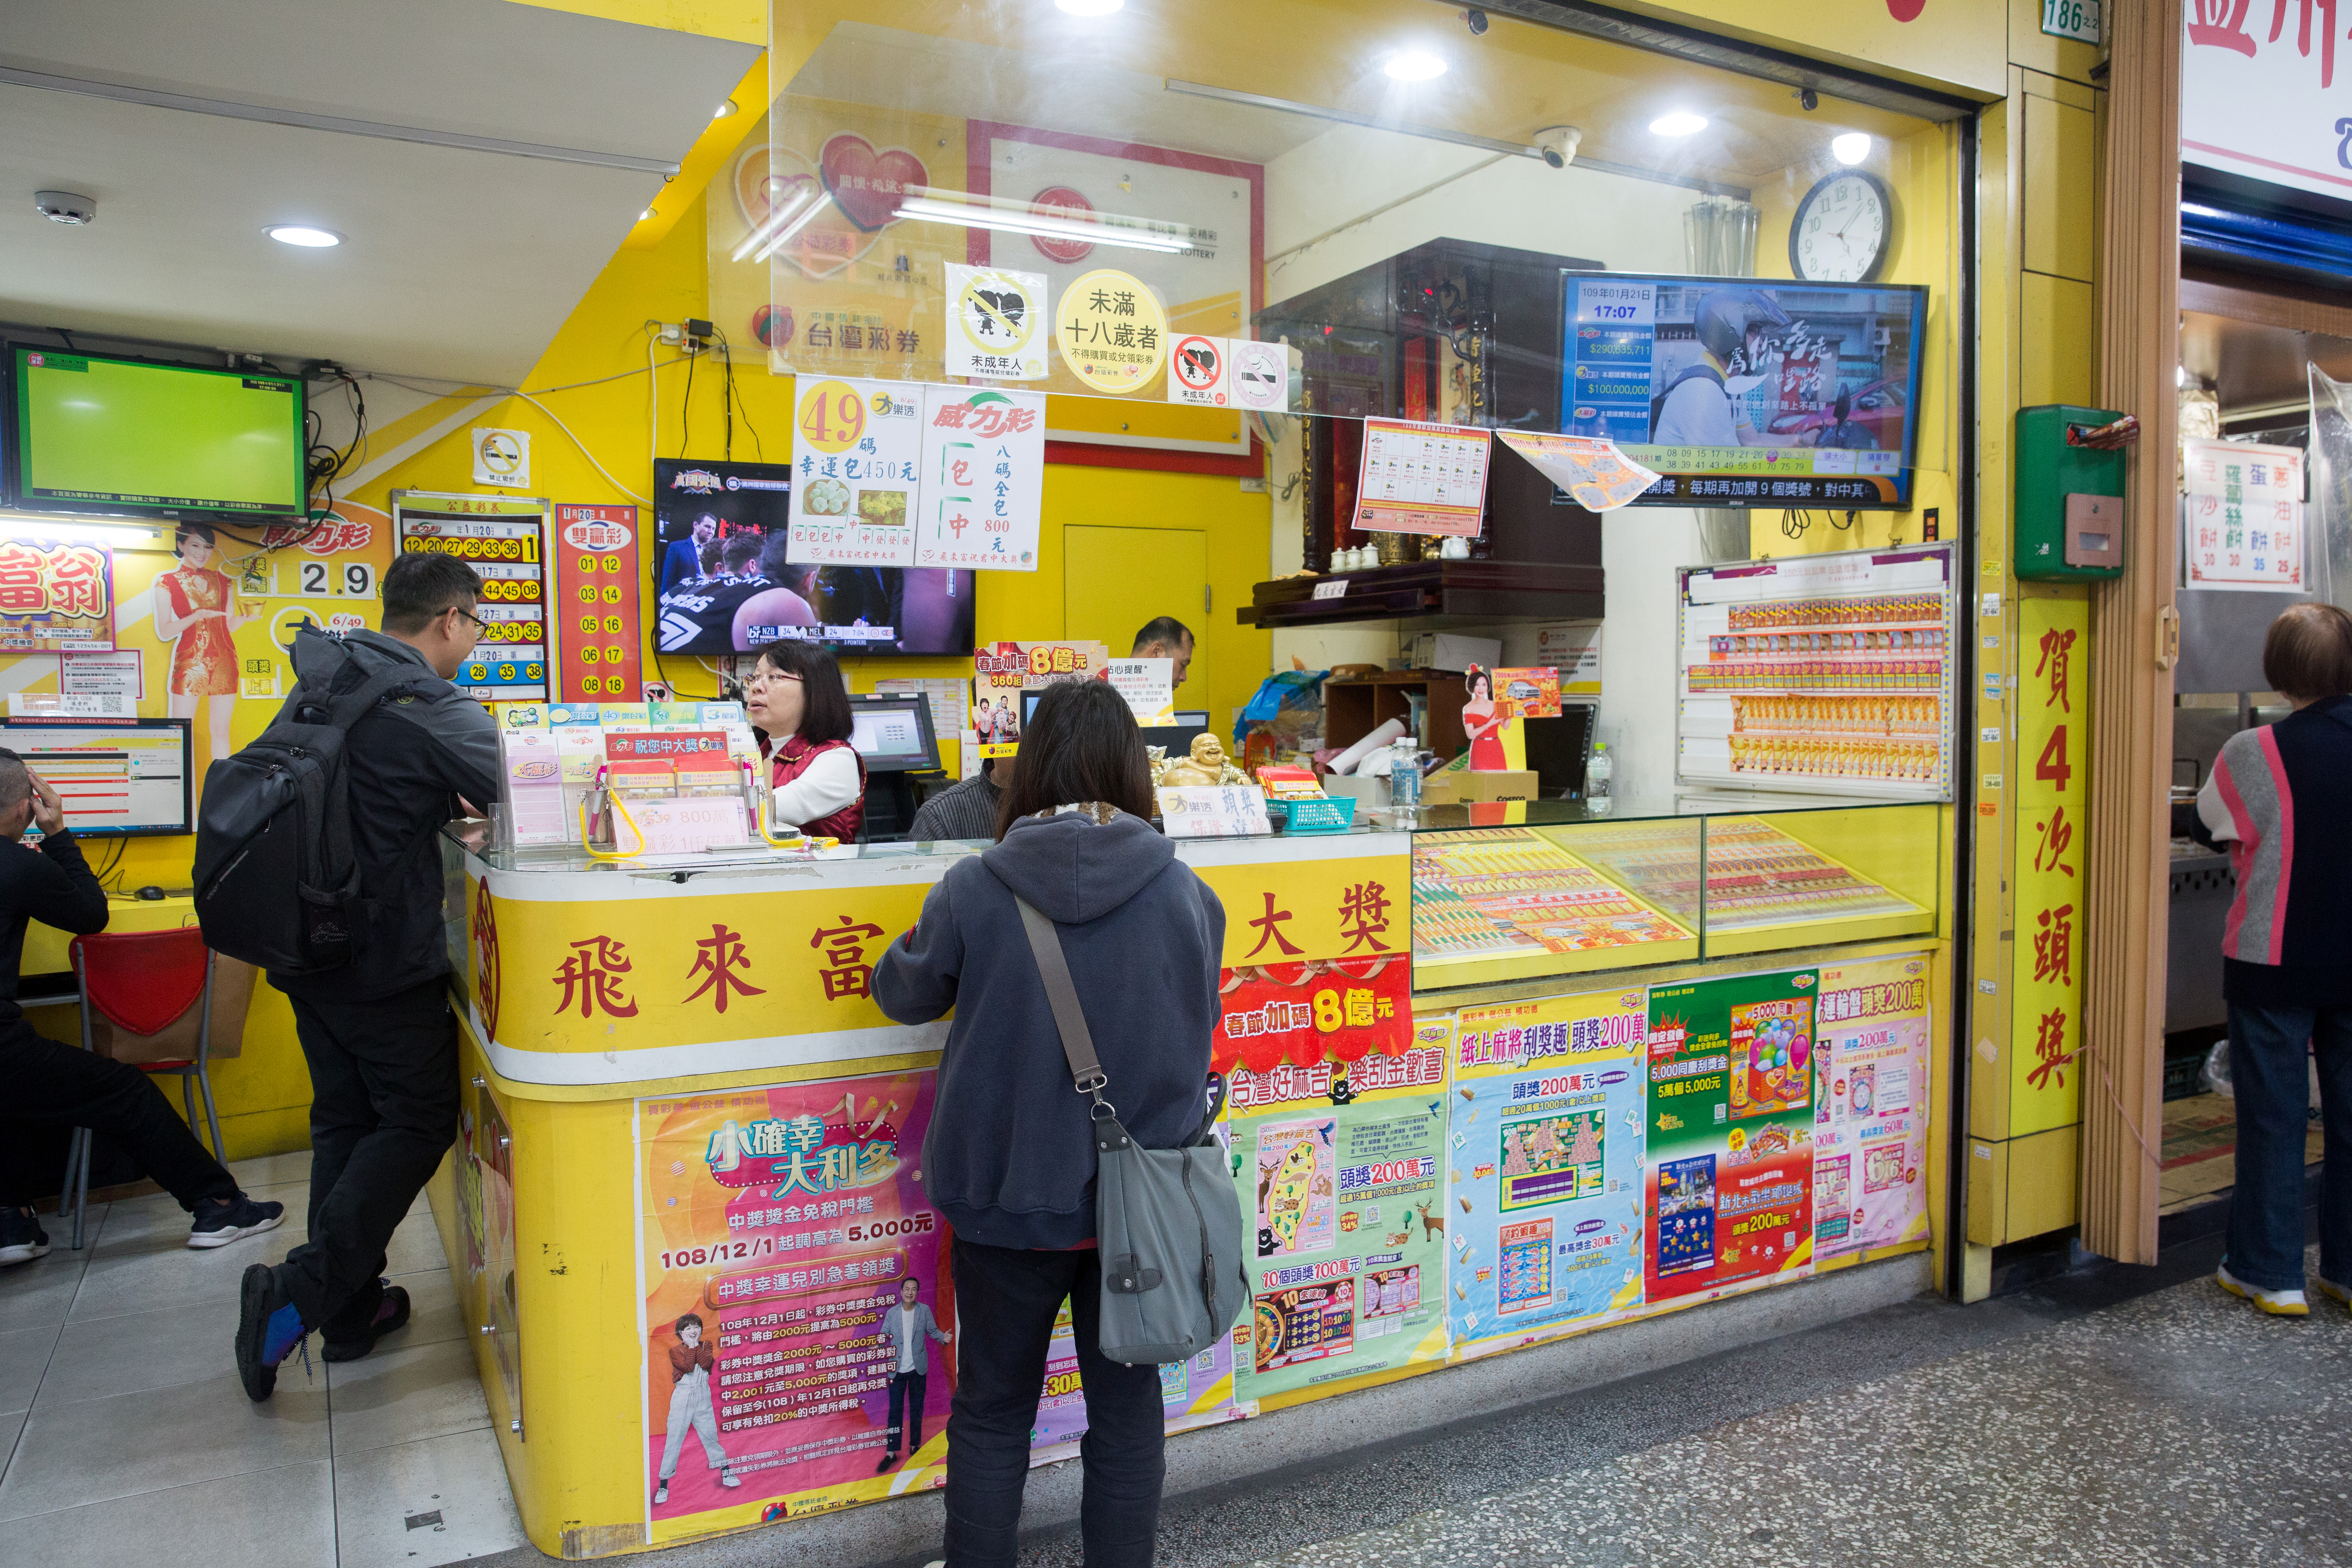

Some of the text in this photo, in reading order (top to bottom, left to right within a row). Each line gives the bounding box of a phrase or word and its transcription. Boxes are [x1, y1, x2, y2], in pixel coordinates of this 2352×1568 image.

[1180, 247, 1216, 260] LOTTERY
[1089, 289, 1135, 316] 未滿
[1583, 288, 1650, 301] 109年01月21日
[1594, 305, 1637, 318] 17:07
[808, 323, 920, 353] 台灣彩券
[1066, 318, 1158, 350] 十八歲者
[1071, 348, 1154, 365] 不得購買或兌領彩券
[1590, 344, 1650, 355] $290,635,711
[971, 355, 1022, 370] 未成年人
[974, 368, 1020, 376] 不得購買或兌領彩券
[1182, 390, 1214, 400] 未成年人
[1588, 384, 1649, 395] $100,000,000
[900, 396, 915, 405] 6/49
[803, 391, 877, 454] 49 碼
[933, 392, 1037, 439] 威力彩
[799, 455, 917, 482] 幸運包450元
[446, 500, 502, 514] 公益彩券
[2199, 459, 2218, 549] 豆沙餅
[2250, 464, 2268, 551] 蛋餅
[410, 522, 442, 536] 威力彩
[849, 520, 858, 530] 中
[572, 527, 622, 545] 雙贏彩
[406, 537, 535, 560] 12 20 27 29 33 36 1
[828, 549, 896, 560] 飛來富祝君中大獎
[581, 559, 617, 570] 01 12
[939, 551, 1018, 564] 飛來富祝君中大獎
[2204, 554, 2289, 573] 30 30 35 25
[303, 564, 368, 594] 2.9
[485, 584, 538, 597] 44 45 08
[581, 588, 618, 601] 03 14
[333, 616, 361, 627] 6/49
[581, 619, 619, 631] 05 16
[489, 624, 540, 638] 24 31 35
[762, 627, 775, 635] NZB
[809, 628, 822, 636] MEL
[583, 650, 619, 662] 06 17
[247, 659, 270, 673] 頭獎
[473, 665, 540, 677] 28 35 38
[248, 679, 271, 695] 上看
[584, 680, 622, 691] 08 18
[635, 738, 699, 754] 祝您中大獎
[519, 762, 558, 776] 大福彩
[1168, 795, 1214, 813] 大樂透
[680, 809, 729, 824] 800萬
[2027, 627, 2077, 1091] 賀4次頭獎
[552, 880, 1392, 1019] 飛來富 大獎
[1861, 980, 1924, 1016] 頭獎200萬
[1571, 1013, 1645, 1053] 頭獎200萬
[1844, 1031, 1896, 1049] 頭獎200萬元
[1232, 1047, 1443, 1105] 台灣好麻吉 樂刮金歡喜
[1651, 1057, 1728, 1080] 5,000同慶刮獎金
[1512, 1073, 1595, 1099] 頭獎200萬元
[648, 1095, 766, 1116] 買彩券 做公益 積功德
[1263, 1128, 1316, 1145] 台灣好麻吉
[708, 1120, 822, 1171] 小確幸
[774, 1143, 899, 1200] 大利多
[1340, 1156, 1435, 1190] 頭獎200萬元
[729, 1196, 875, 1231] 中獎獎金免稅門檻
[1341, 1221, 1358, 1231] 34%
[1732, 1213, 1791, 1237] 頭獎200萬元
[661, 1213, 933, 1269] 108/12/1 起調高為 5,000元
[1558, 1234, 1621, 1255] 最高獎金30萬元
[719, 1258, 895, 1299] 中獎幸運兒別急著領獎
[1262, 1256, 1362, 1289] 10個頭獎100萬元
[1281, 1290, 1299, 1308] 10
[1234, 1334, 1251, 1344] 33%
[721, 1347, 897, 1385] 請您注意兌獎期限，如您購買的彩券對
[1048, 1359, 1078, 1372] 刮到忘我
[793, 1496, 828, 1508] 中國信託金控
